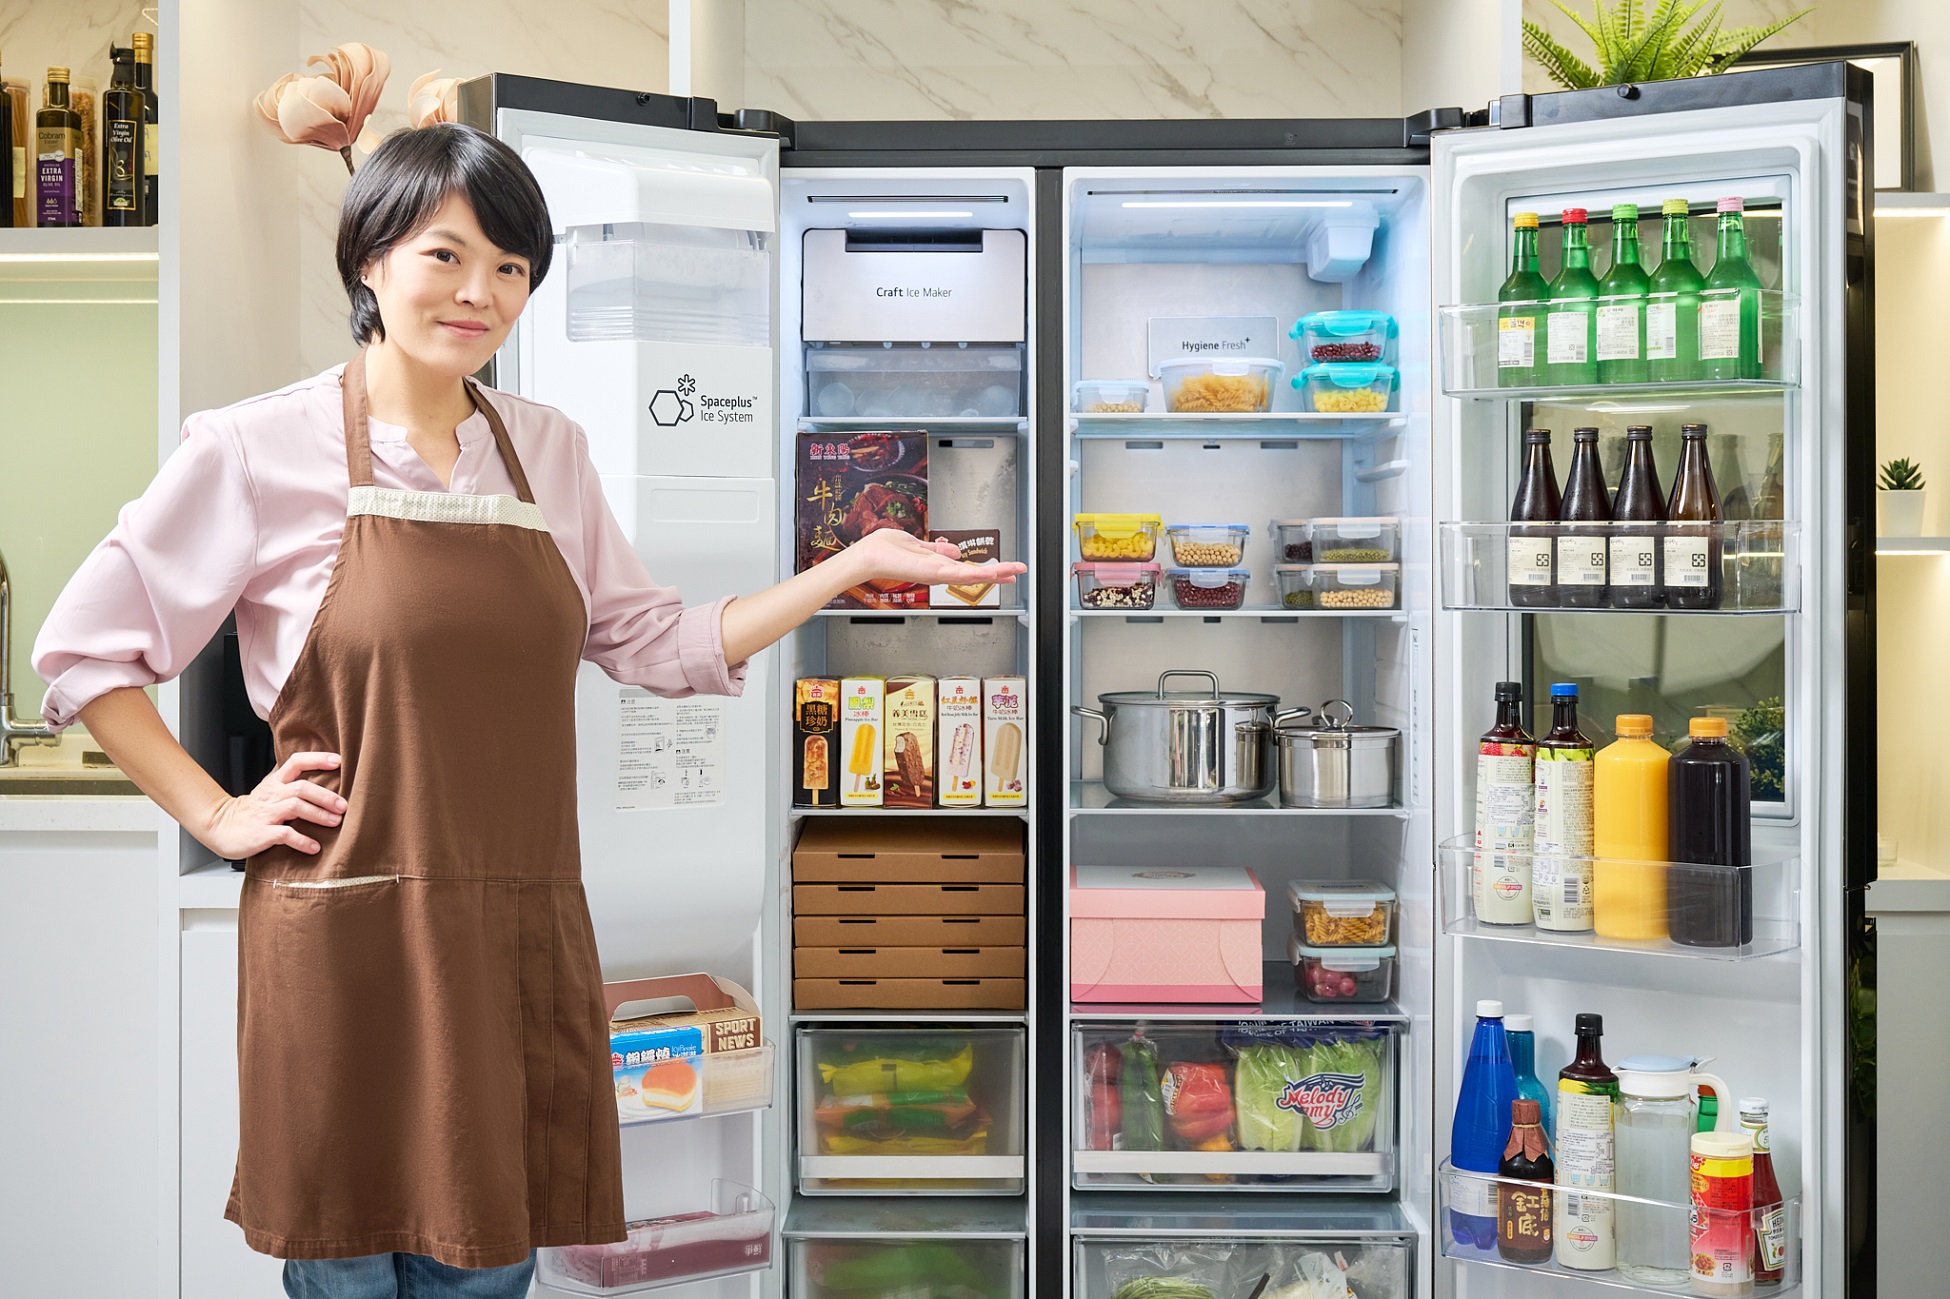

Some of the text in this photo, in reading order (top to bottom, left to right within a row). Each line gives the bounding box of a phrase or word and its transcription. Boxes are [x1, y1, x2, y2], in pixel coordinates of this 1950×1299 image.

[38, 132, 66, 140] Cobram
[112, 130, 130, 138] Virgin
[876, 287, 952, 297] Craft Ice Maker
[1182, 341, 1219, 352] Hygiene
[700, 410, 753, 425] Ice System
[810, 443, 850, 455] 新東陽
[848, 696, 875, 710] 鳳梨
[805, 704, 828, 715] 黑糖
[805, 716, 828, 726] 珍奶
[715, 1018, 756, 1036] SPORT
[718, 1033, 755, 1051] NEWS
[1280, 1085, 1349, 1108] Melody
